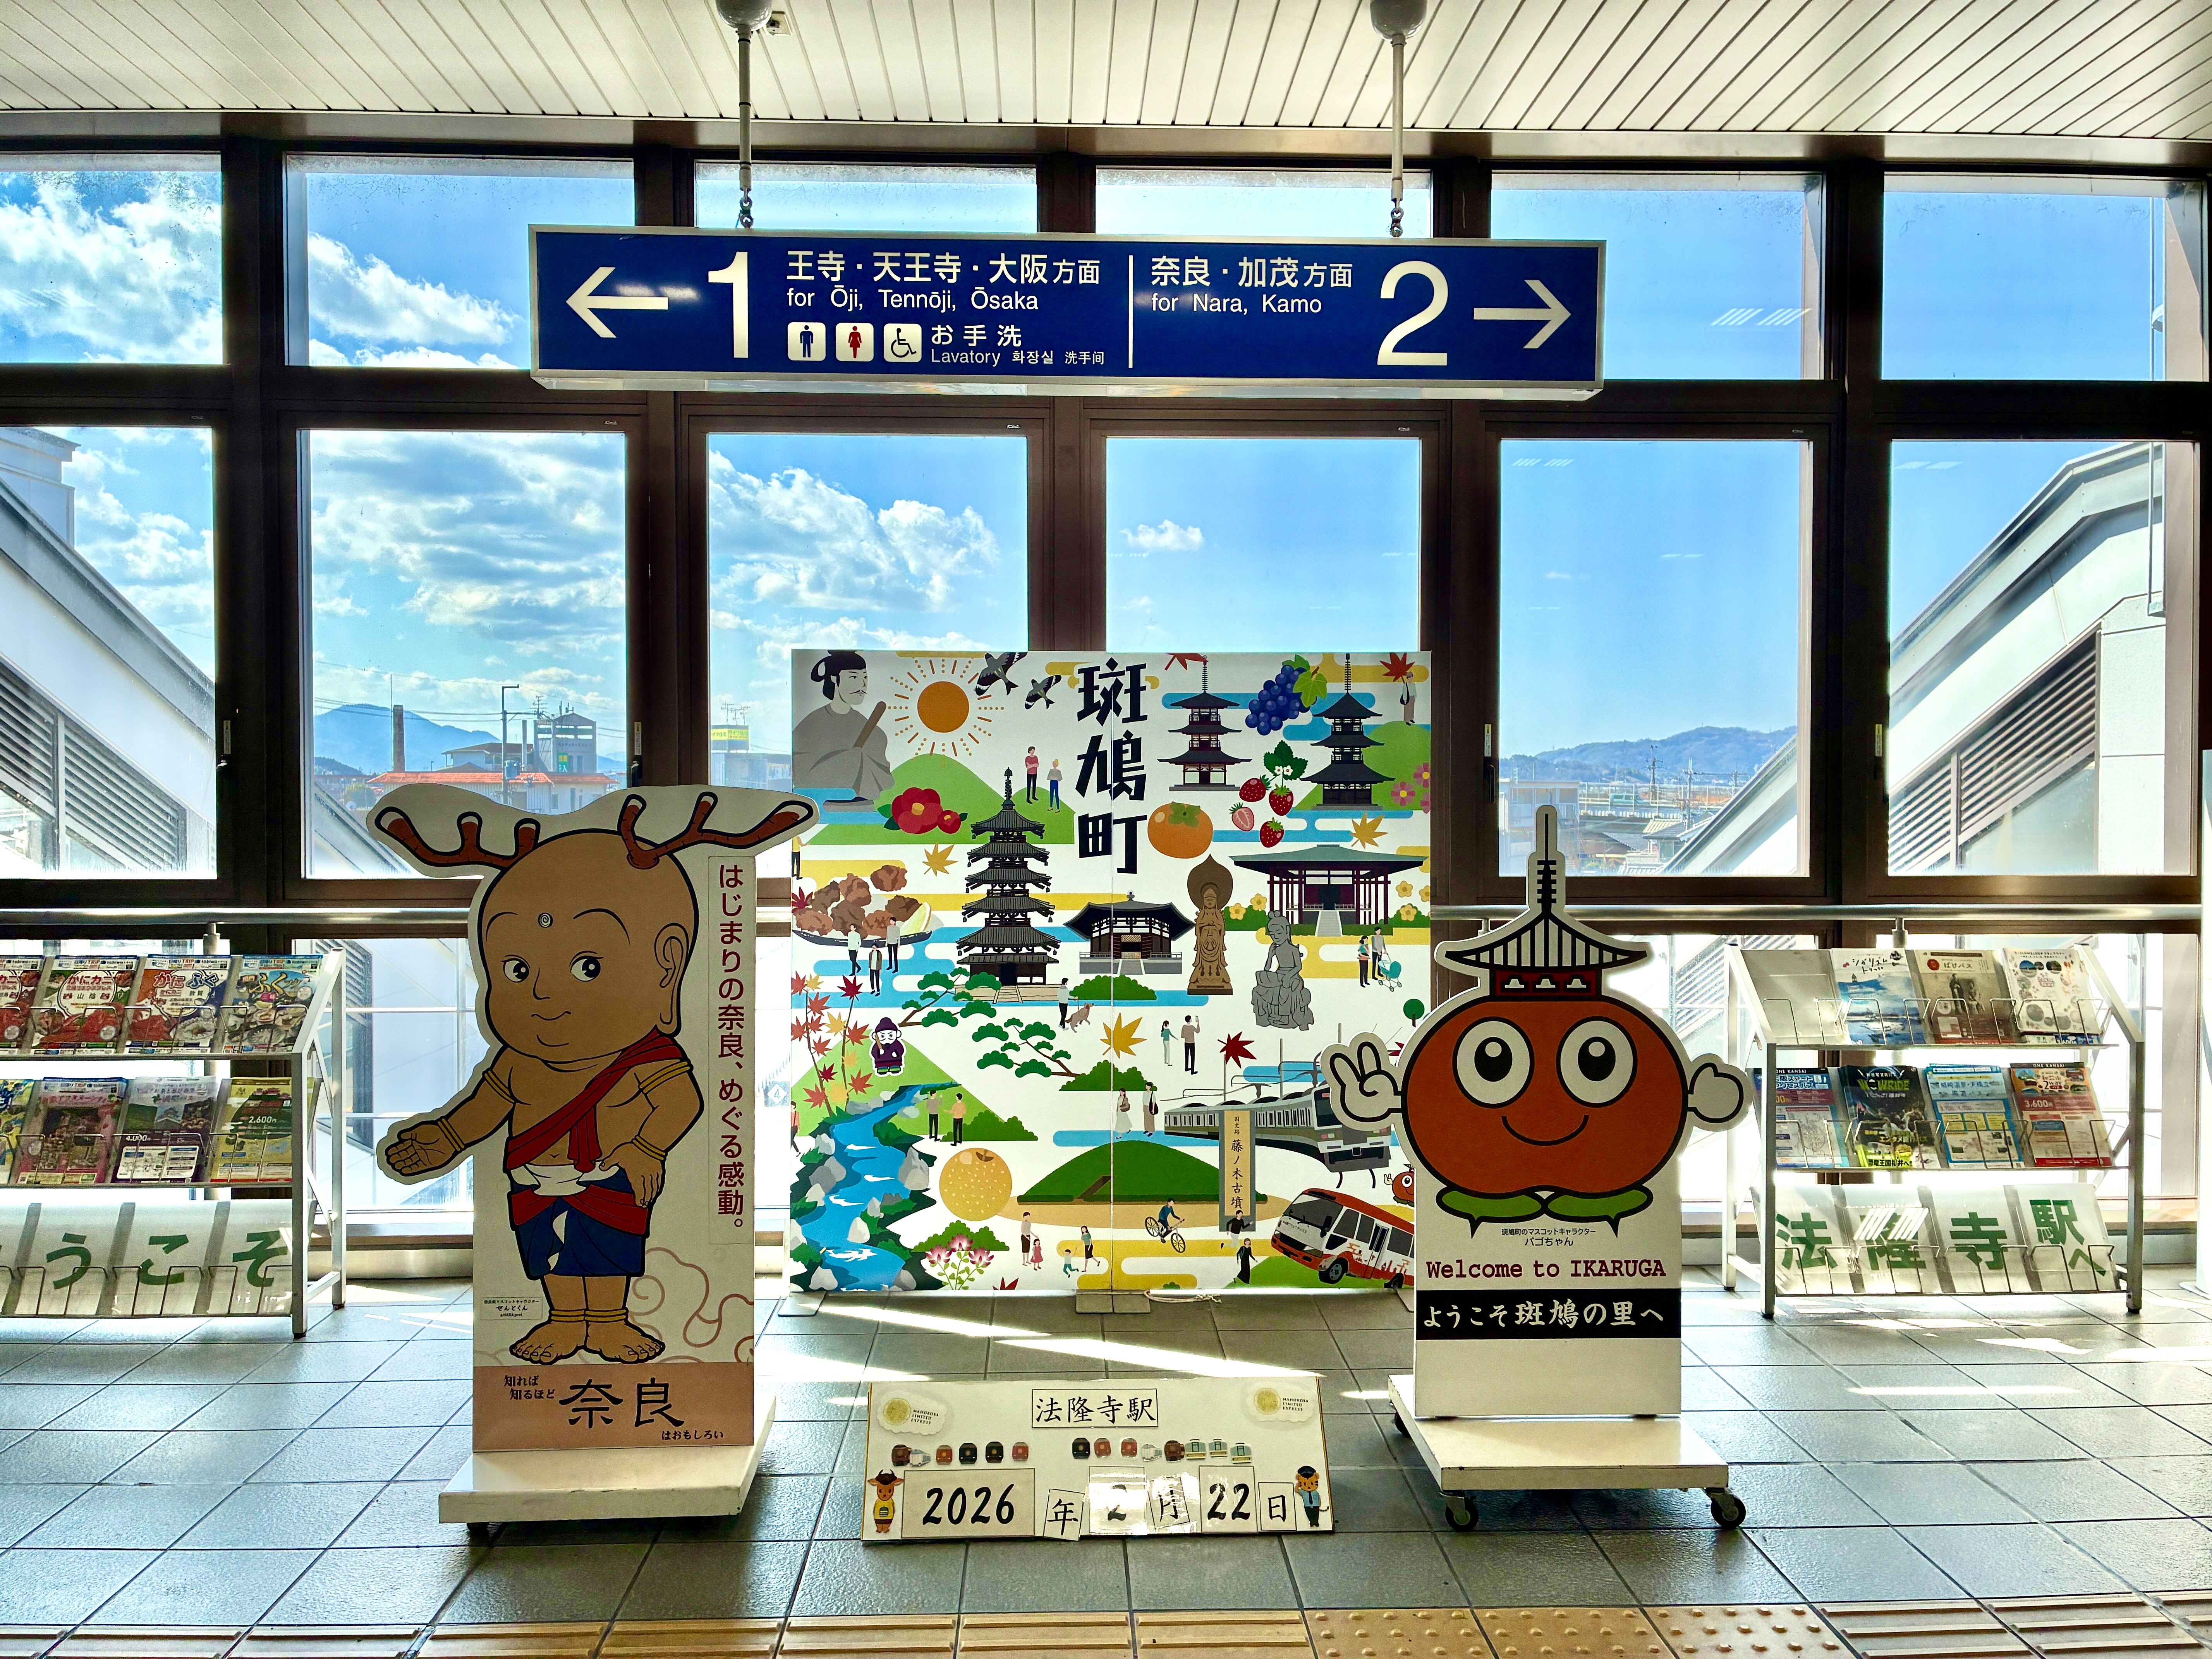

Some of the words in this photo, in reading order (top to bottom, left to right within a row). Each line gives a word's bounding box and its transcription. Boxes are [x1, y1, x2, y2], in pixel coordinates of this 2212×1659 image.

[787, 251, 1100, 284] 王寺・天王寺・大阪方面
[1151, 256, 1352, 287] 奈良・加茂方面
[708, 252, 748, 358] 1
[787, 288, 814, 307] for
[831, 286, 862, 311] Ōji,
[882, 289, 955, 311] Tennōji,
[971, 287, 1038, 309] Ōsaka
[1152, 293, 1178, 311] for
[1193, 294, 1247, 314] Nara,
[1263, 294, 1321, 313] Kamo
[1377, 261, 1448, 366] 2
[932, 325, 1021, 346] お手洗
[932, 349, 1000, 366] Lavatory
[1012, 350, 1053, 364] 화장실
[1065, 351, 1104, 364] 洗手间
[1075, 658, 1147, 874] 斑鳩町
[153, 972, 185, 988] かに
[186, 972, 219, 989] ふぐ
[718, 865, 744, 1227] はじまりの奈良、めぐる感動。
[1231, 1139, 1244, 1209] 藤ノ木古墳
[0, 1231, 287, 1290] うこそ
[1426, 1259, 1522, 1278] Welcome
[1534, 1260, 1560, 1278] to
[1571, 1259, 1666, 1277] IKARUGA
[1424, 1298, 1664, 1329] ようこそ斑鳩の里へ
[504, 1375, 539, 1387] 知れば
[510, 1388, 555, 1400] 知るほど
[559, 1377, 685, 1429] 奈良
[1036, 1396, 1156, 1424] 法隆寺駅
[661, 1430, 724, 1440] はおもしろい
[923, 1484, 1014, 1525] 2026
[1048, 1498, 1079, 1536] 年
[1207, 1484, 1251, 1520] 22
[1268, 1495, 1286, 1522] 日
